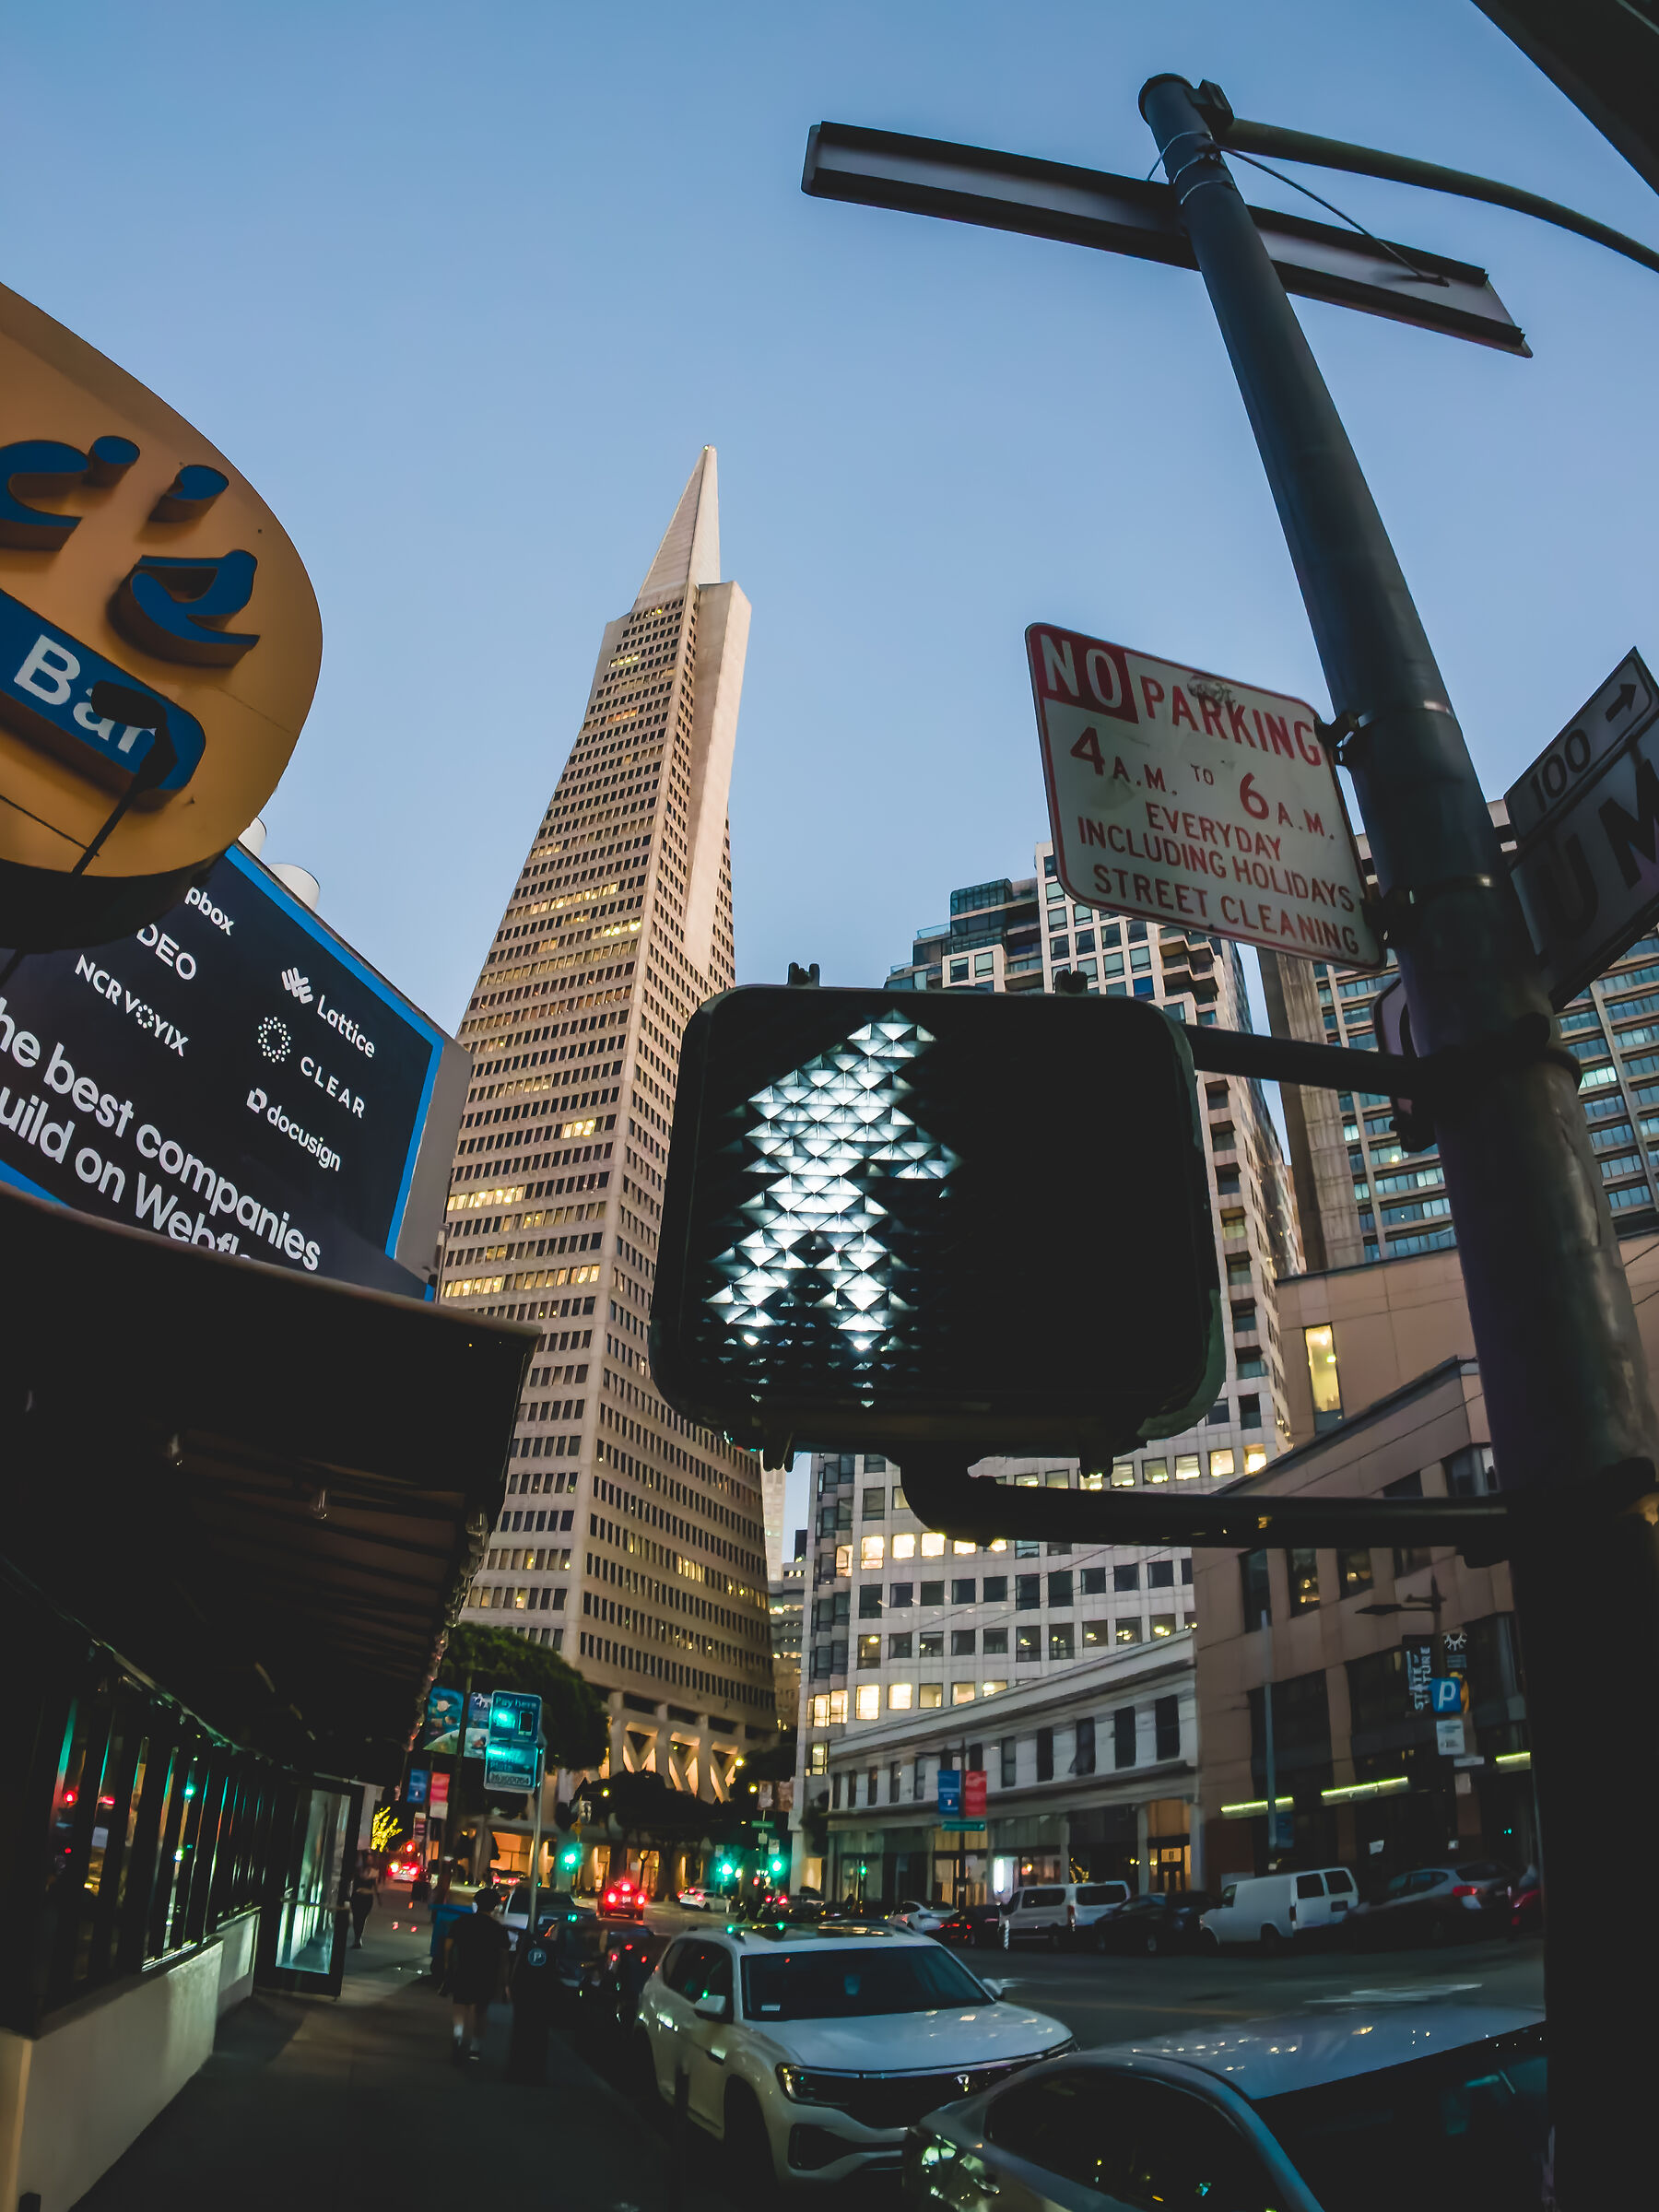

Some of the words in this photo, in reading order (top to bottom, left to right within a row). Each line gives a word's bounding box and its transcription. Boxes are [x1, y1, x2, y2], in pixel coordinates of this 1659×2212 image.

[1041, 634, 1122, 708] NO
[1140, 675, 1322, 767] PARKING
[1191, 763, 1214, 785] TO
[1530, 729, 1591, 813] 100
[1077, 816, 1227, 878] INCLUDING
[1232, 855, 1355, 912] HOLIDAYS
[1146, 802, 1281, 861] EVERYDAY
[1093, 865, 1208, 917] STREET
[1220, 896, 1359, 955] CLEANING
[75, 954, 122, 1006] NCR
[125, 990, 189, 1057] VOYIX
[317, 994, 375, 1058] Lattice
[300, 1056, 365, 1119] CLEAR
[43, 1041, 135, 1138] best
[136, 1124, 321, 1271] companies
[266, 1105, 342, 1171] docusign
[75, 1147, 126, 1204] on
[135, 1172, 251, 1259] Webfl
[1438, 1680, 1456, 1711] P
